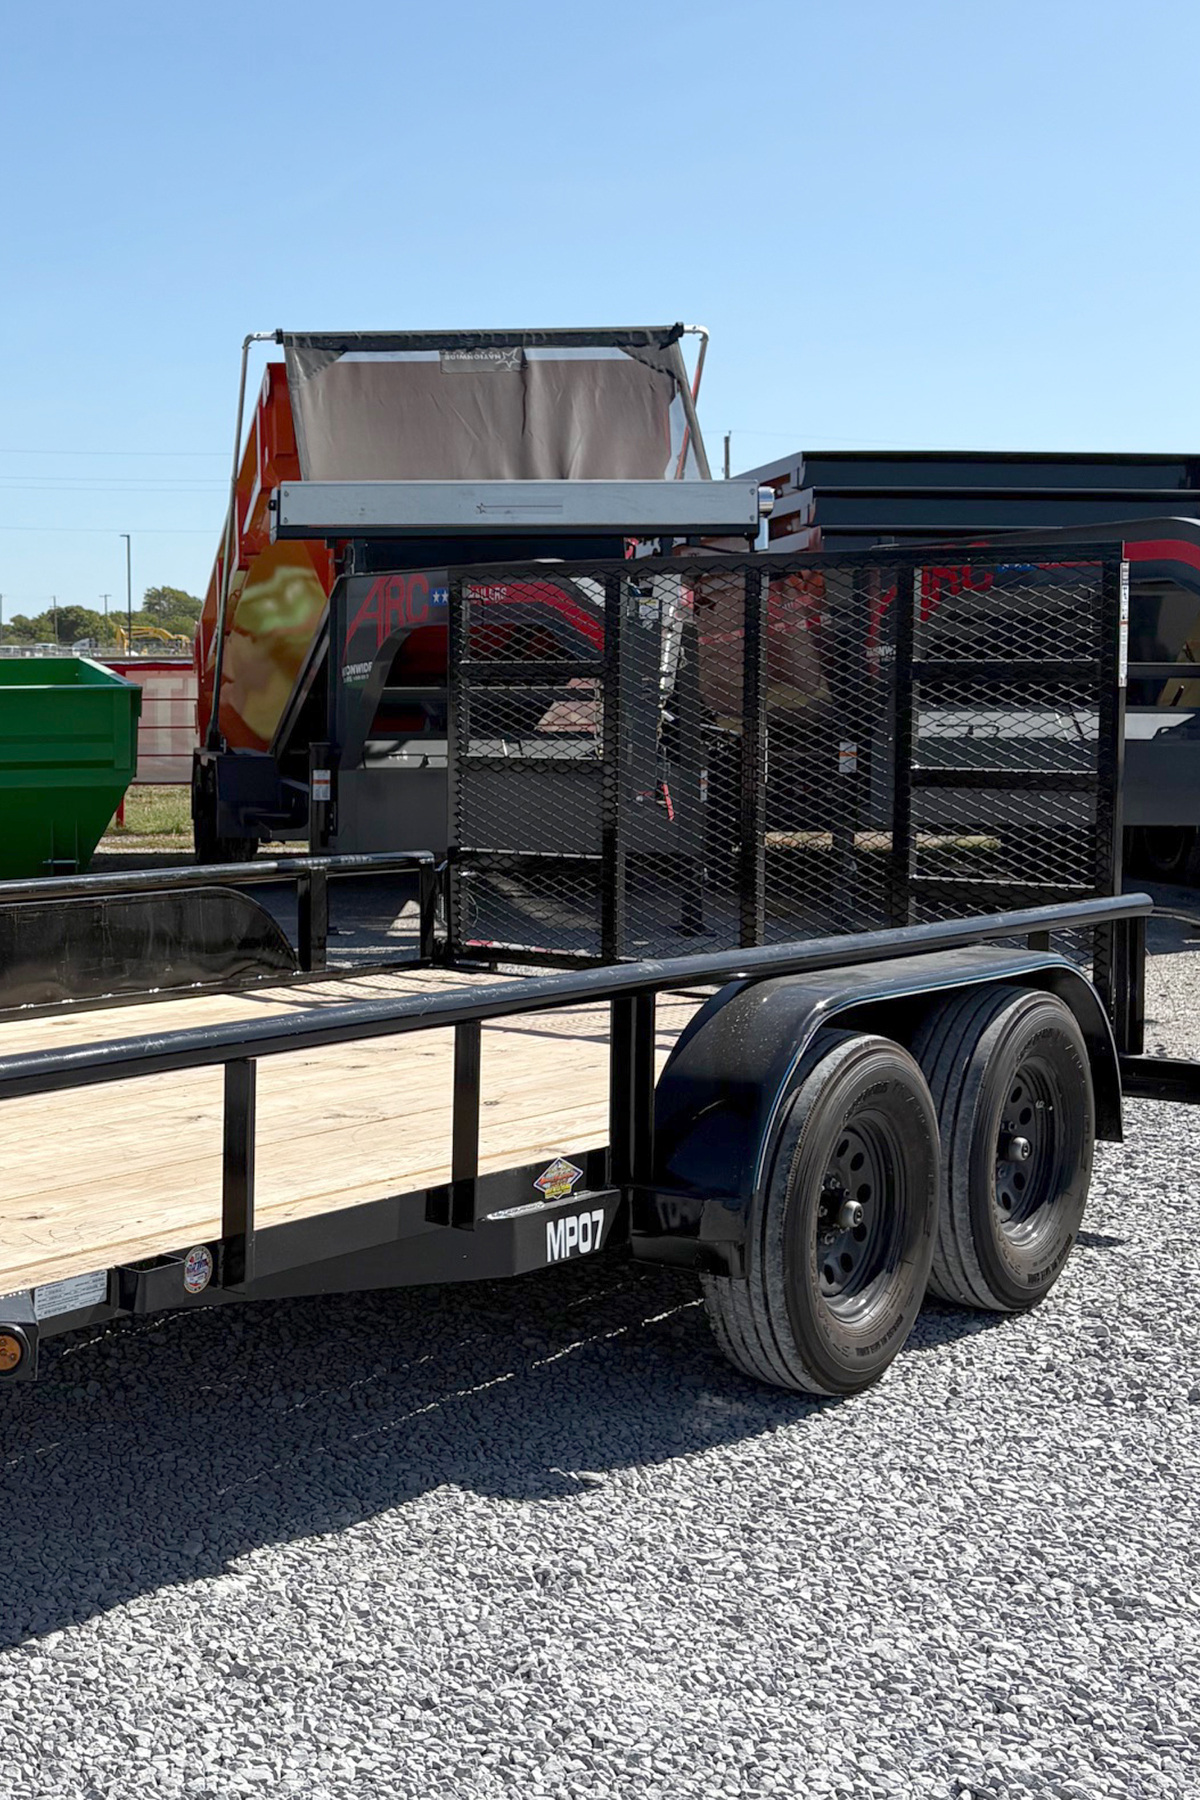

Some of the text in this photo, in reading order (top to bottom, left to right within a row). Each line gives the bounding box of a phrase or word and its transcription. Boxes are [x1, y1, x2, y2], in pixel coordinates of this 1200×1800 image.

[444, 352, 502, 360] NATIONWIDE
[343, 573, 429, 664] ARC
[546, 1208, 605, 1263] MP07
